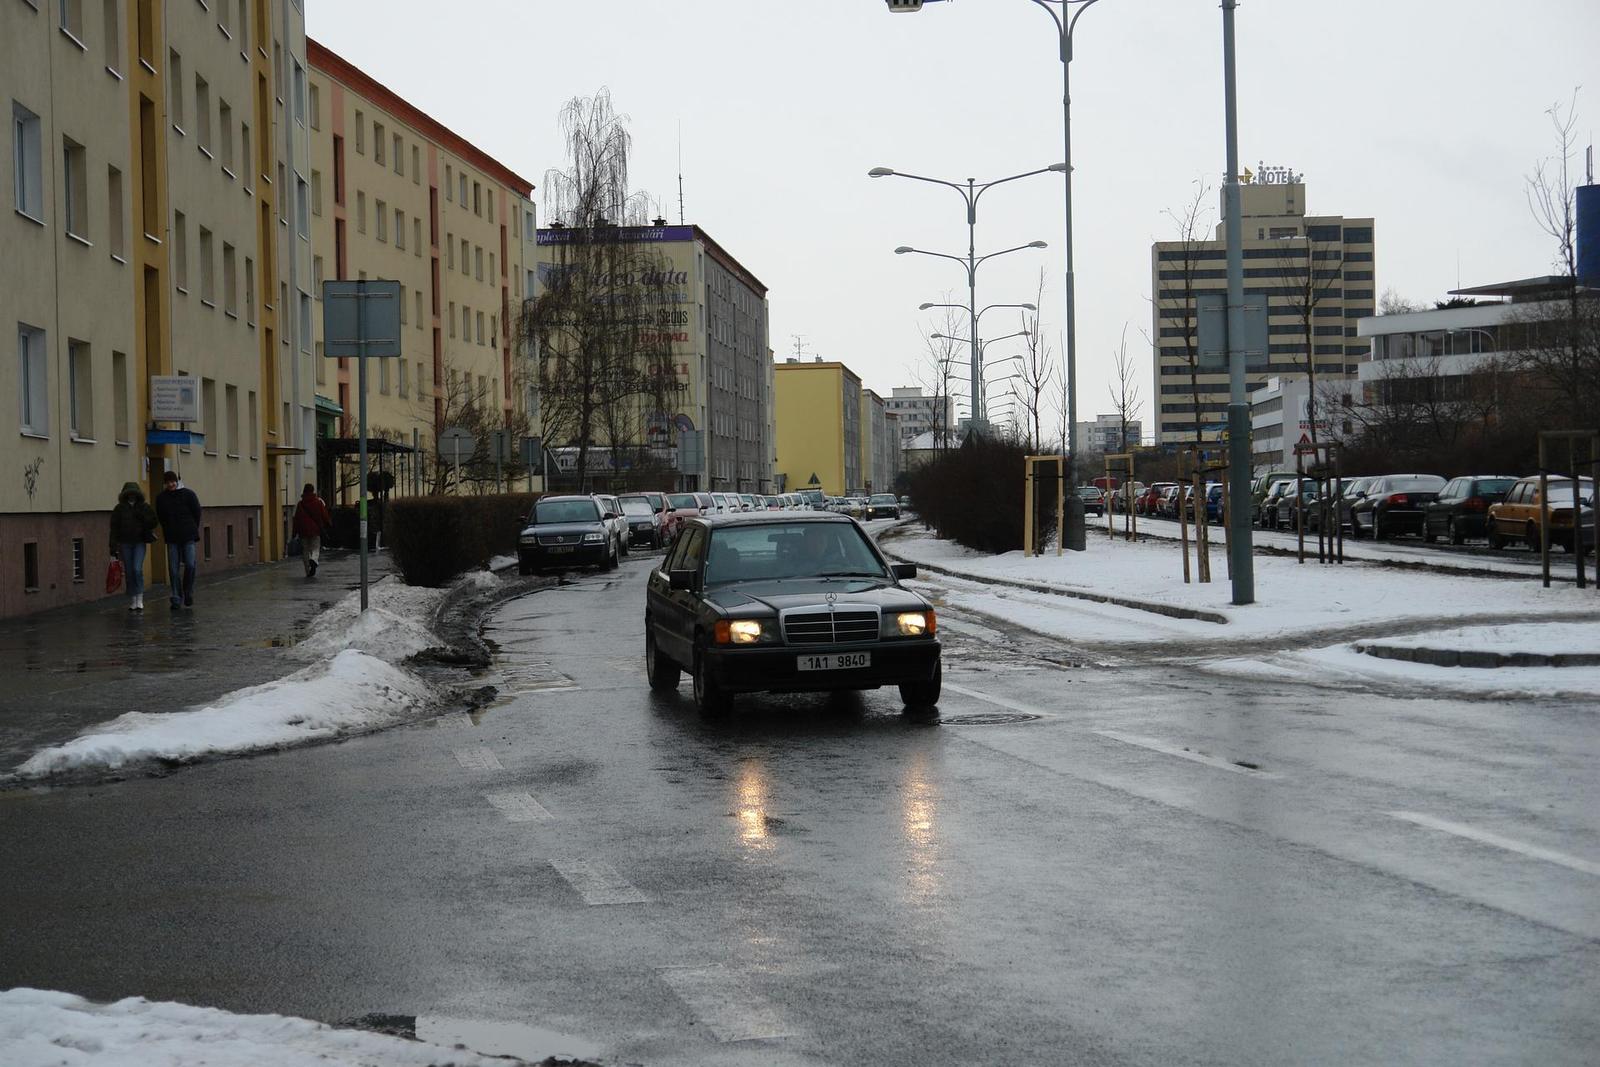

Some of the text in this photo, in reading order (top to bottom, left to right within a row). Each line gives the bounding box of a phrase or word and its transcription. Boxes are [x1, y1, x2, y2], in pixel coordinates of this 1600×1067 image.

[659, 308, 688, 325] Sedus
[808, 654, 866, 669] 1A1 9840
